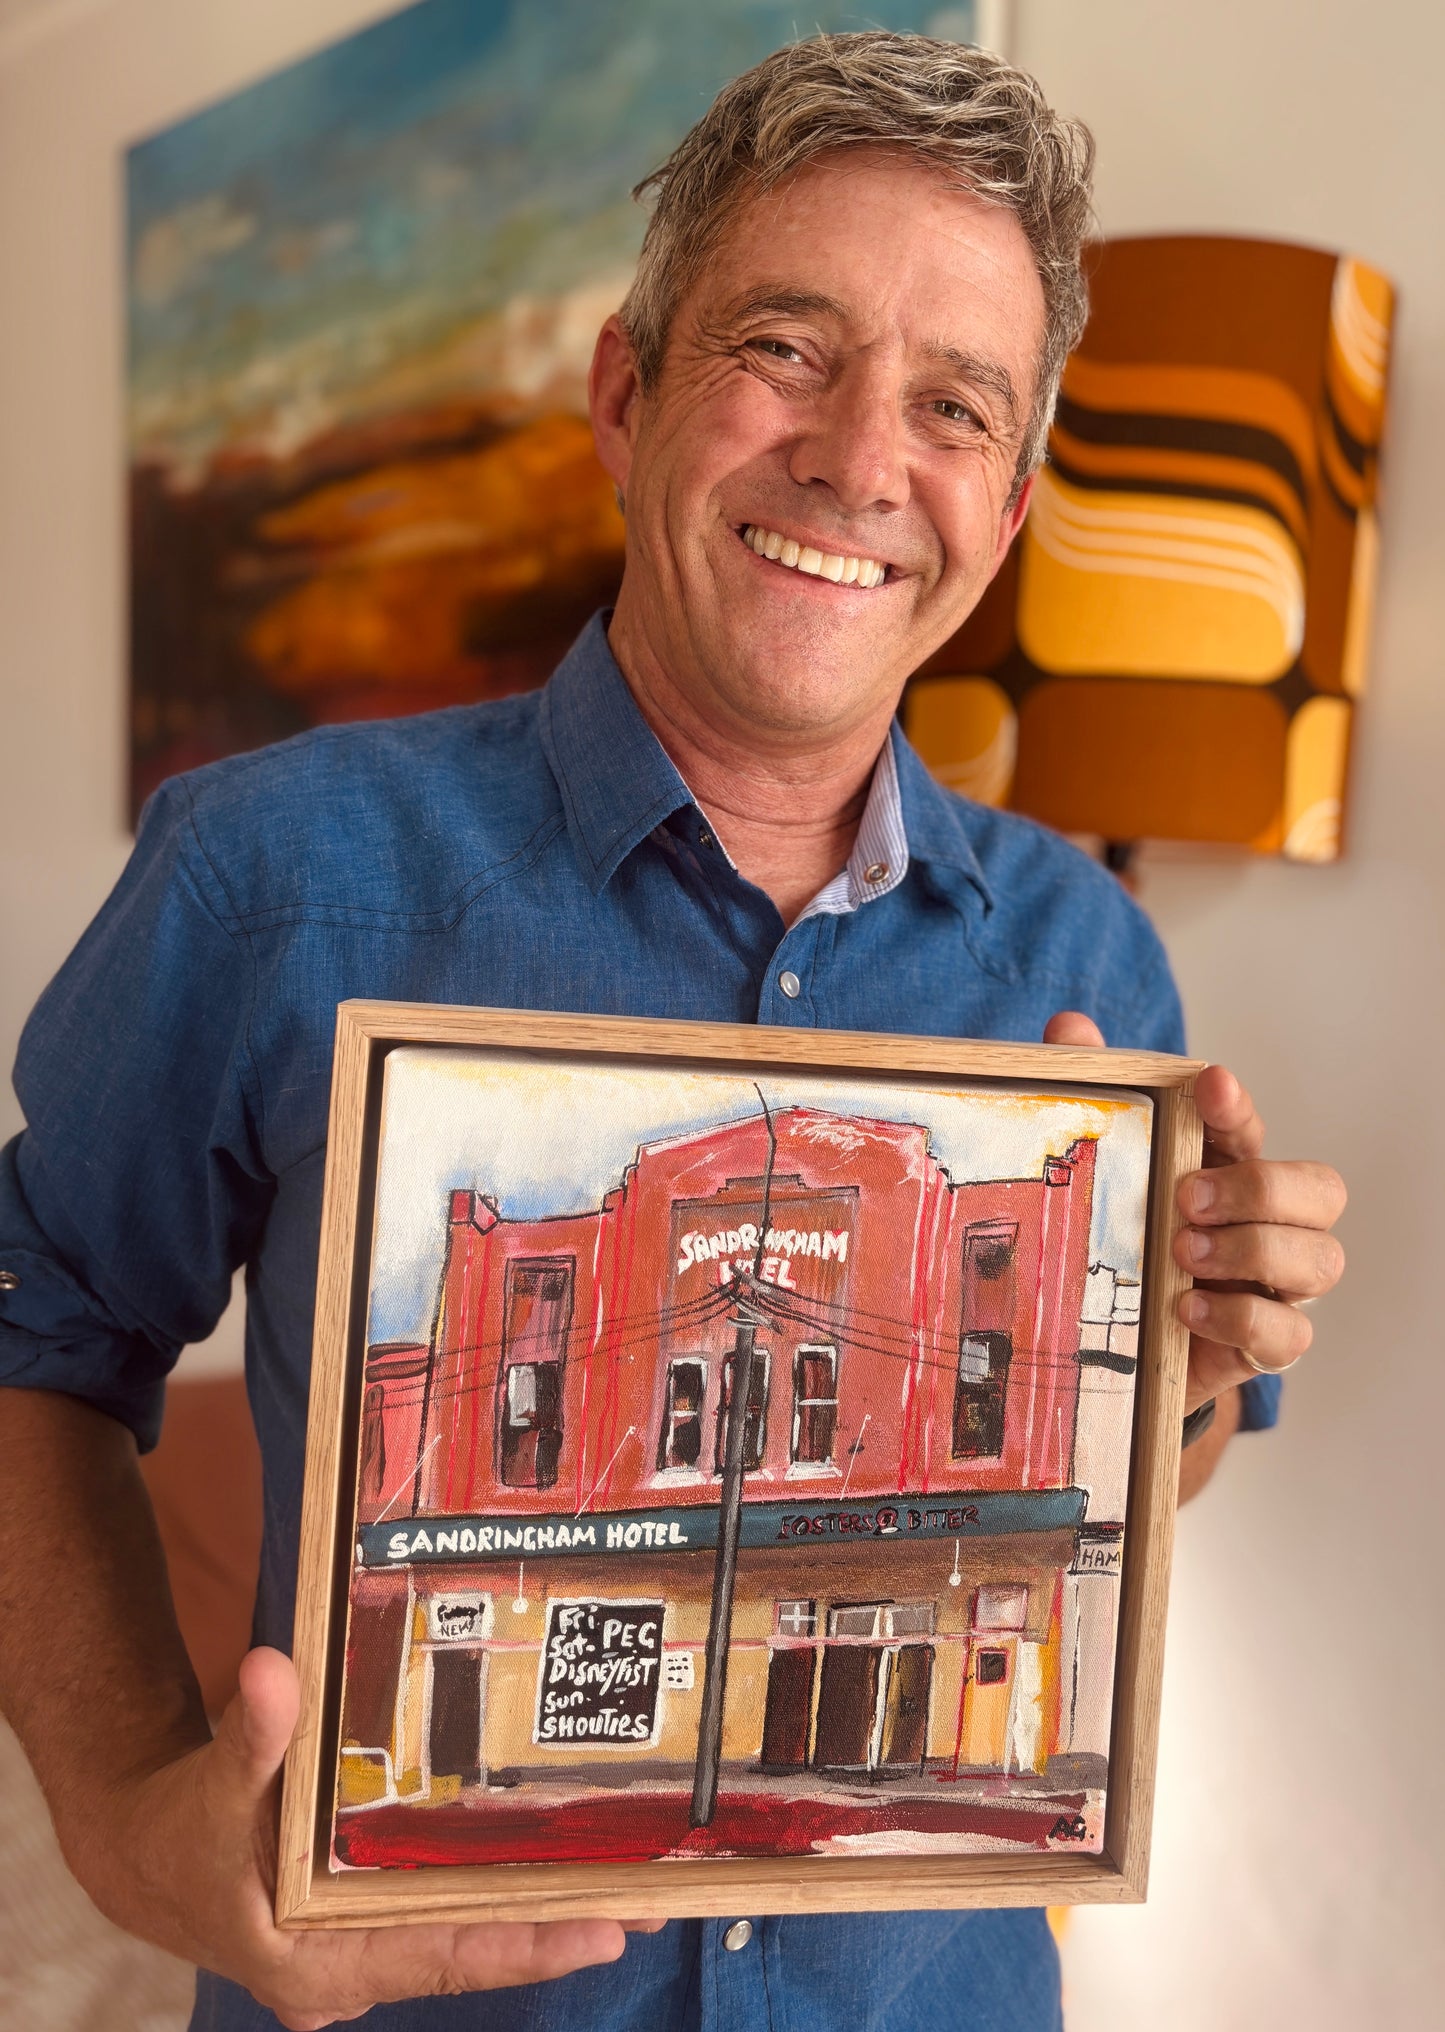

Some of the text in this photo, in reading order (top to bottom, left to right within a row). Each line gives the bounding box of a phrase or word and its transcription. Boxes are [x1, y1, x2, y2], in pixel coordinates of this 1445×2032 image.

[387, 1522, 688, 1558] SANDRINGHAM HOTEL
[1082, 1548, 1121, 1568] HAM
[602, 1618, 657, 1649] PEG
